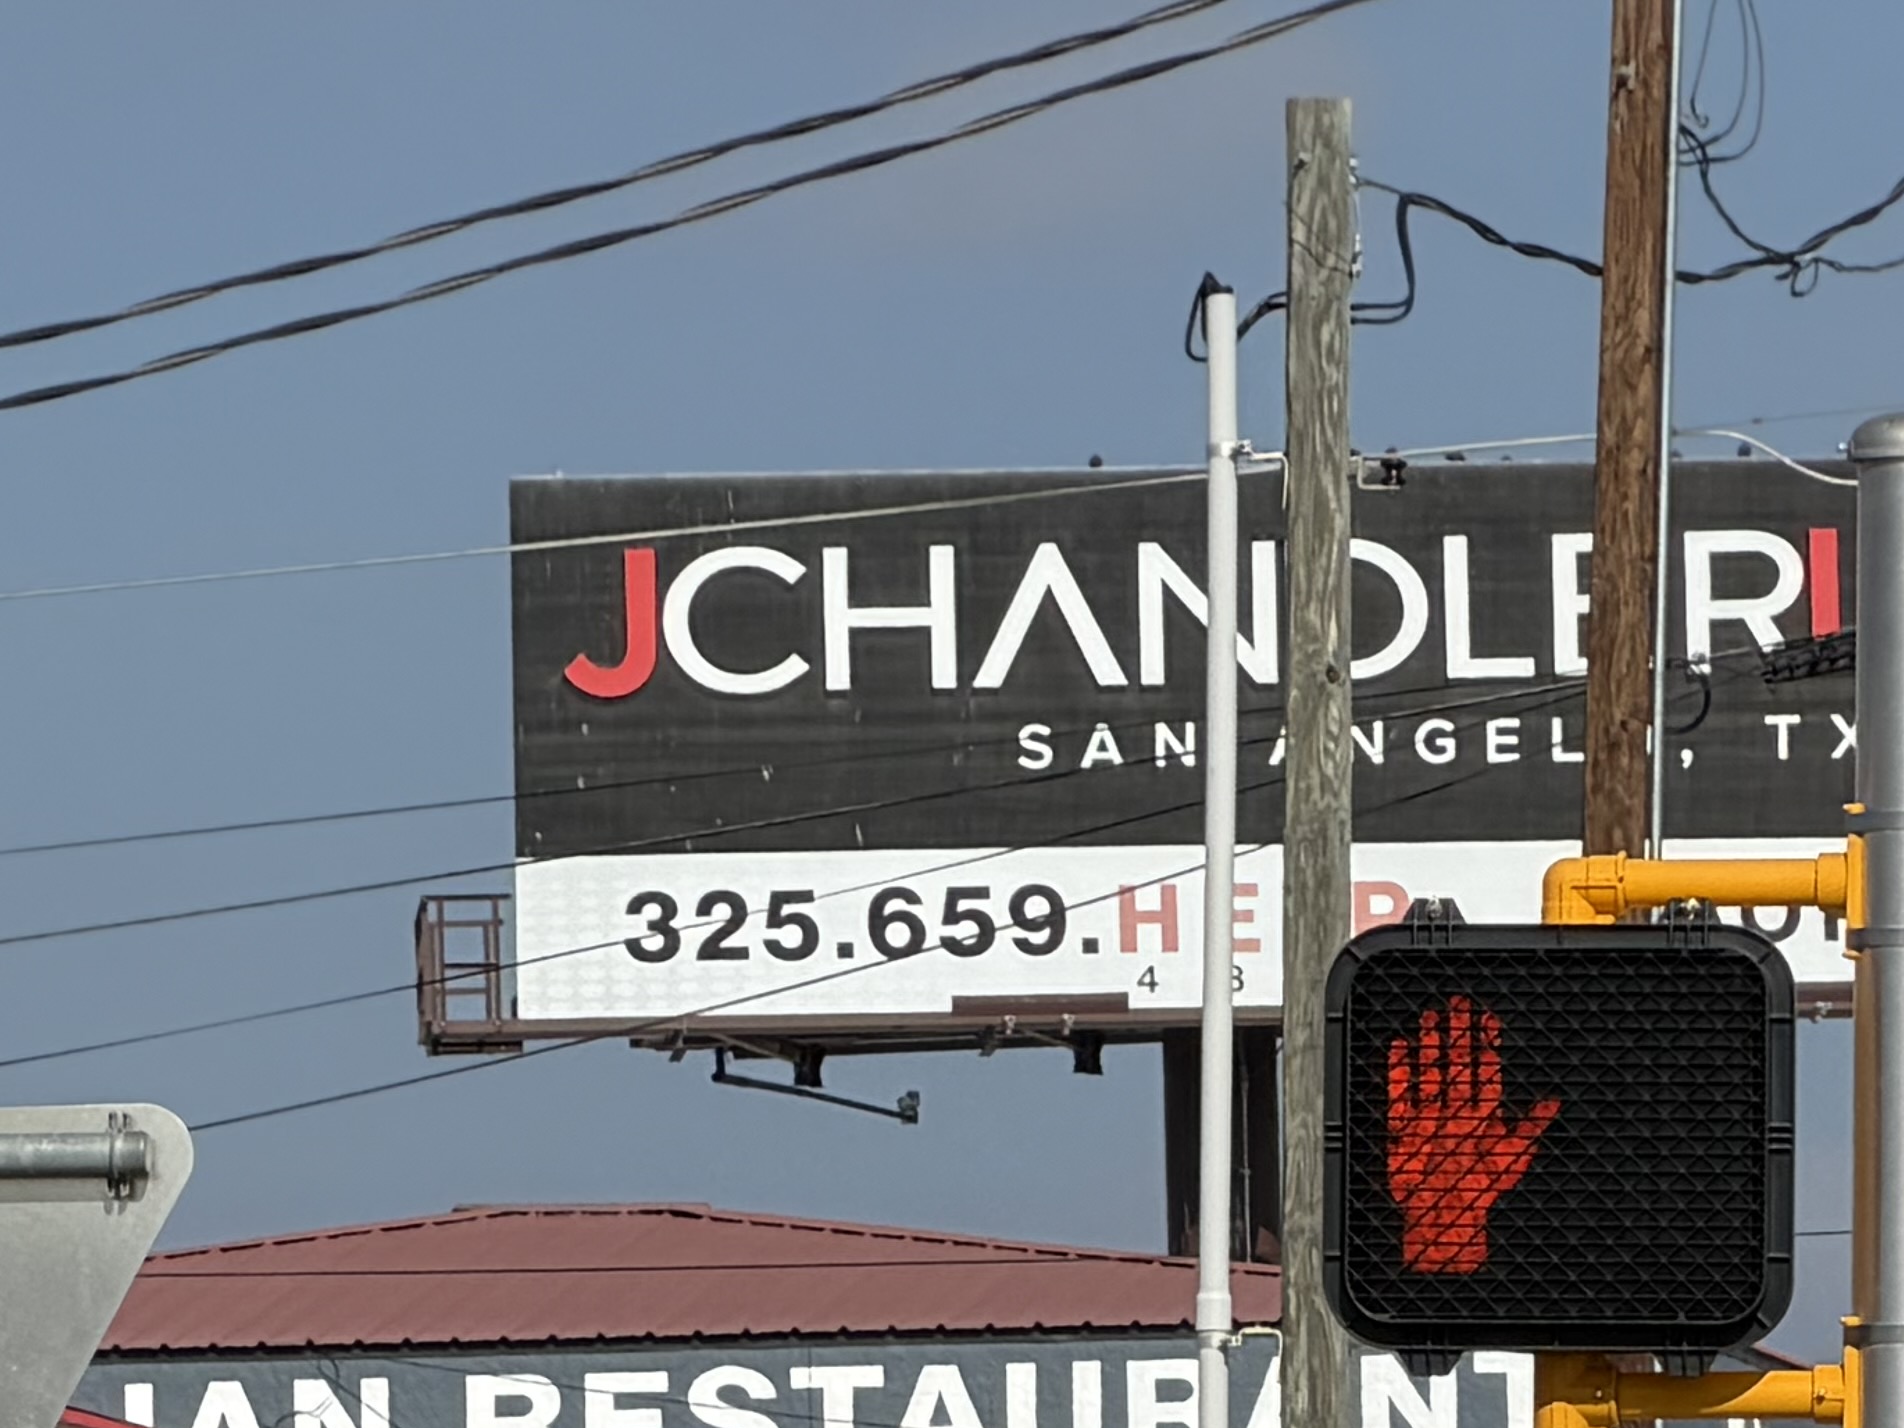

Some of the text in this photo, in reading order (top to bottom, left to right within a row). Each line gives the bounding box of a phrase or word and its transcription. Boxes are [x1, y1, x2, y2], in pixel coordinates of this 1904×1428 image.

[1017, 714, 1854, 769] SAN NGEL, TX
[623, 879, 1410, 964] 325.659.HEP
